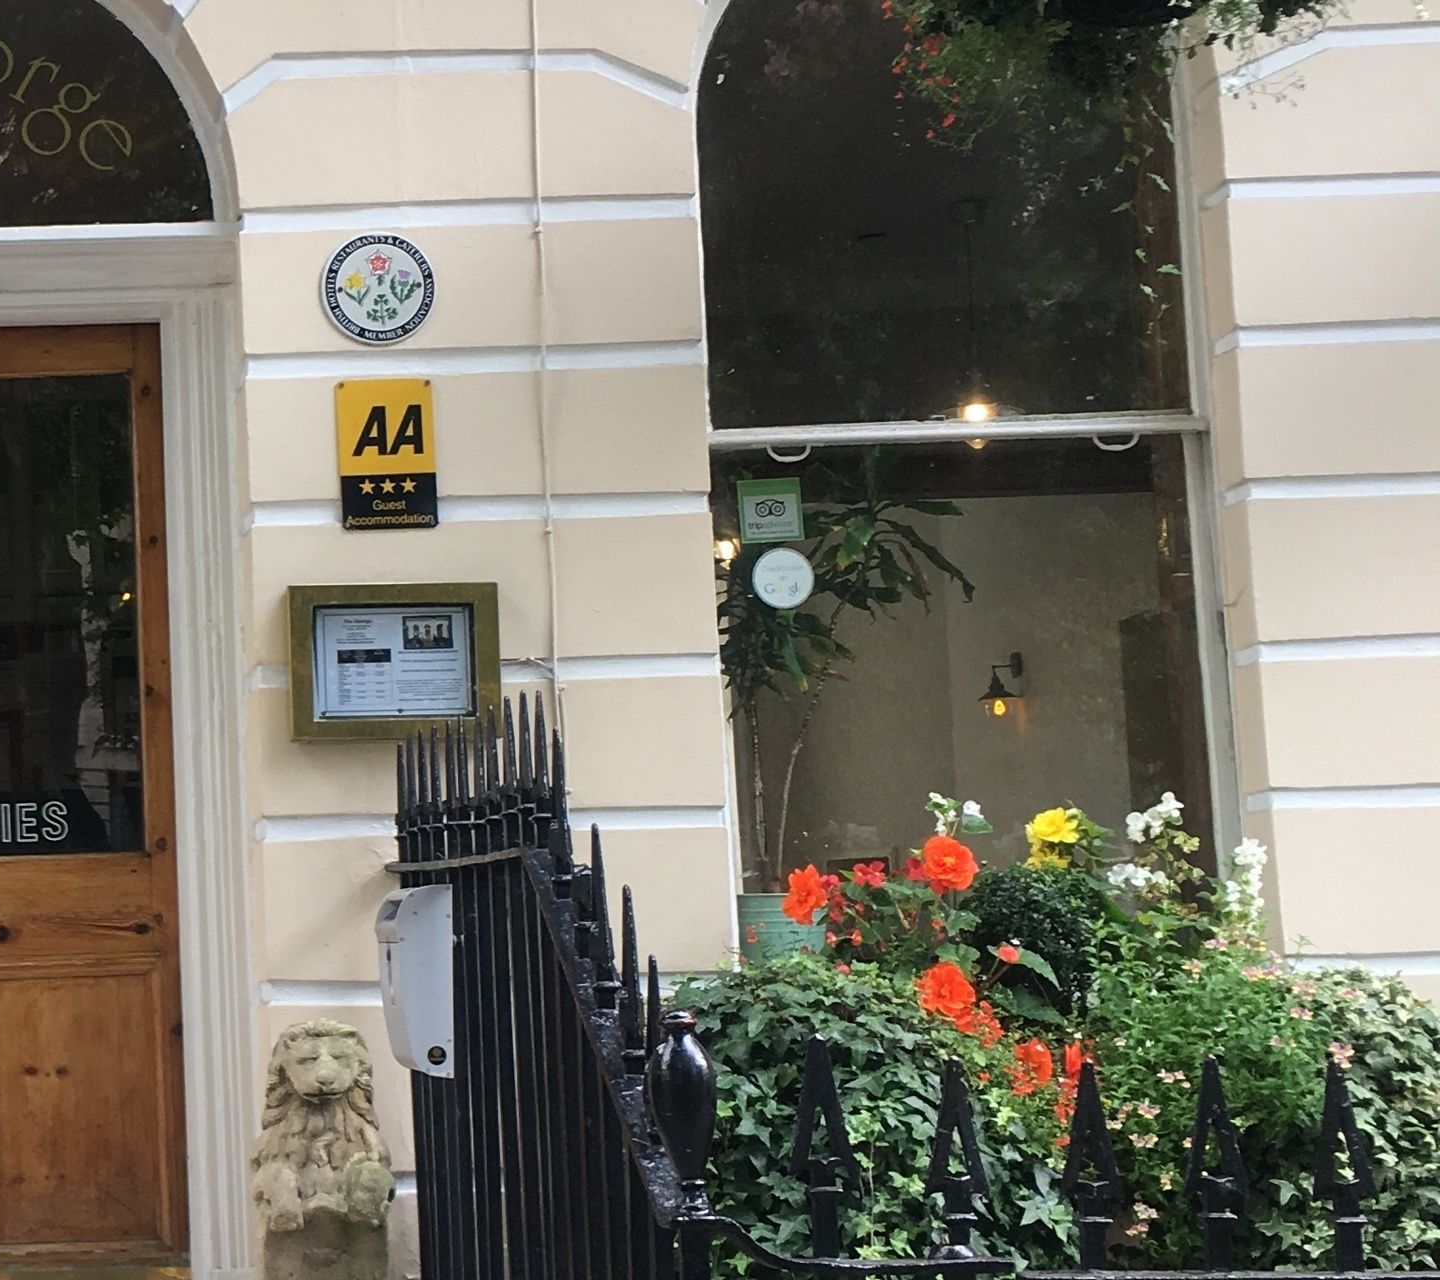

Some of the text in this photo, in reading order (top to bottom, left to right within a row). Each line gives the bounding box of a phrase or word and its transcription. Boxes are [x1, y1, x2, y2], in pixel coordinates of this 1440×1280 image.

[330, 235, 386, 270] RESTAURANTS
[396, 237, 431, 277] CATERERS
[326, 272, 338, 308] HOTELS
[405, 278, 434, 331] ASSOCIATION
[333, 305, 361, 335] BRITISH
[364, 328, 404, 340] MEMBER
[352, 404, 424, 457] AA
[346, 513, 434, 526] Accommodation
[372, 499, 407, 511] Guest
[763, 581, 802, 597] Gogl
